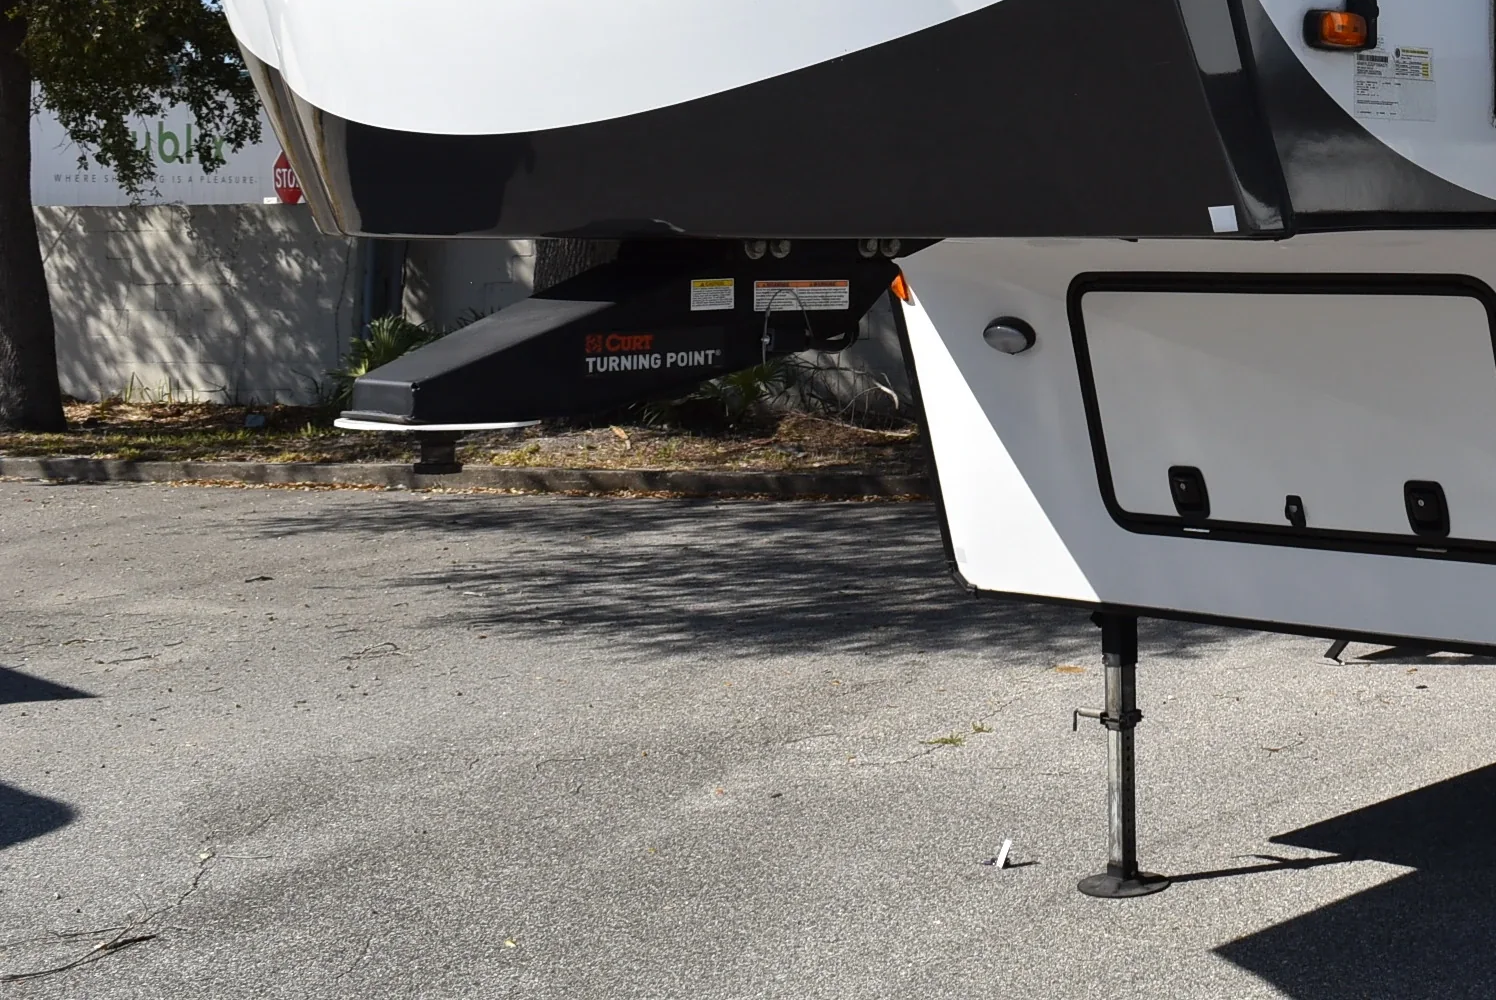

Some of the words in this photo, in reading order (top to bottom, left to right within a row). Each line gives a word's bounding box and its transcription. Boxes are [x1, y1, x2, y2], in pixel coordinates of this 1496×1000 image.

[130, 121, 226, 166] ublx
[53, 174, 97, 183] WHERE
[172, 175, 182, 184] IS
[187, 175, 194, 184] A
[275, 168, 301, 188] STO
[605, 333, 655, 350] CURT
[586, 353, 662, 373] TURNING
